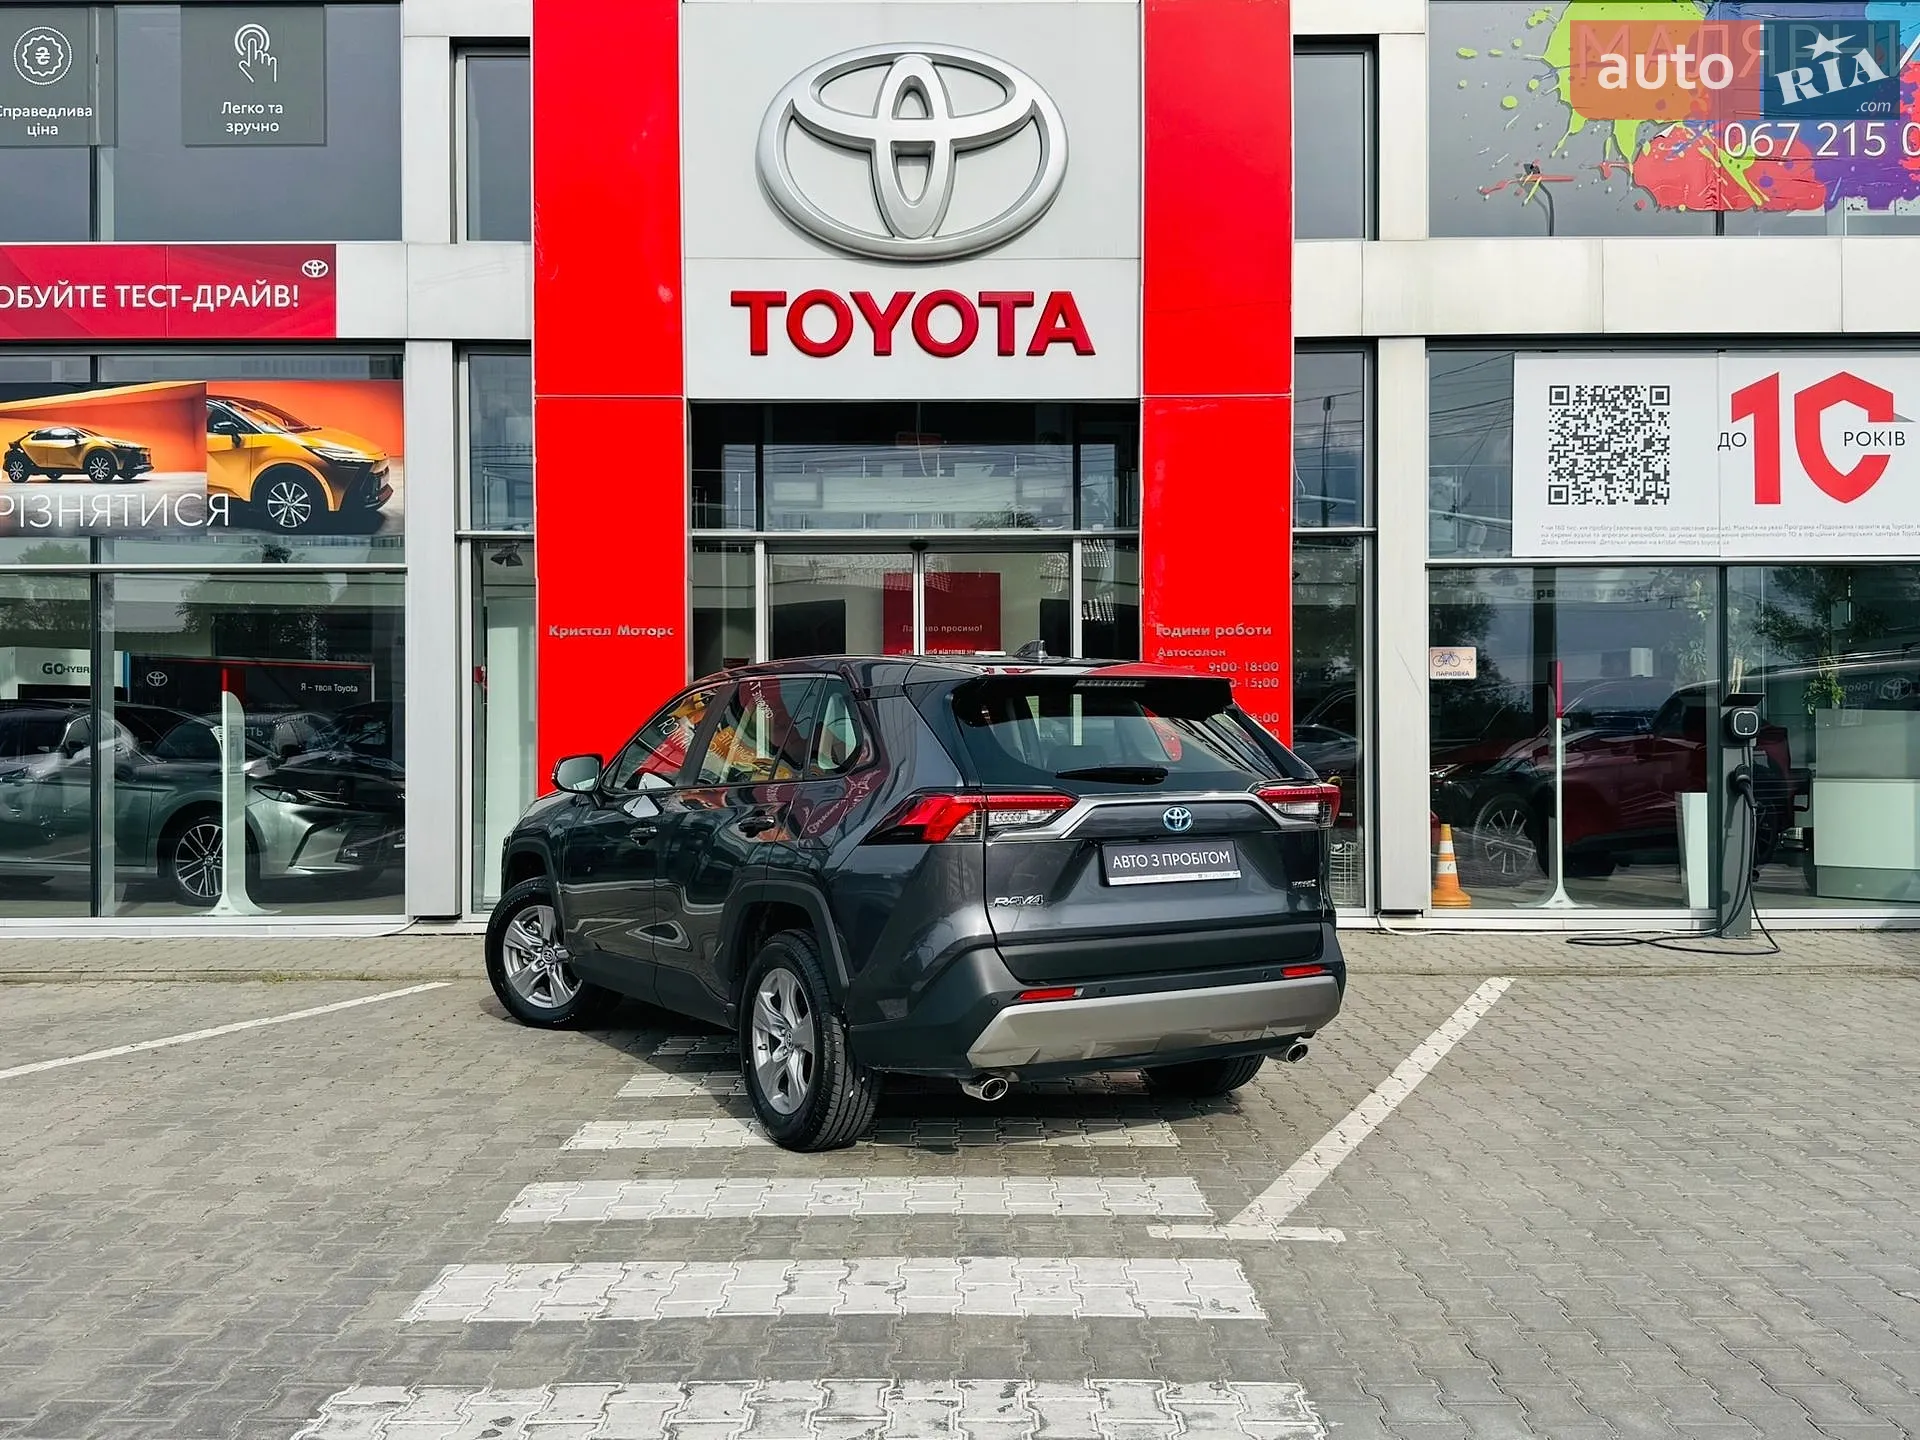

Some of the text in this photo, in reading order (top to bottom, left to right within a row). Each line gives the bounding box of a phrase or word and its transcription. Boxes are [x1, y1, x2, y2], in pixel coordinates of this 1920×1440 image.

[0, 105, 93, 120] праведлива
[221, 101, 283, 114] Легко та
[27, 122, 59, 137] ціна
[226, 121, 280, 133] зручно
[1723, 122, 1800, 157] 067
[1816, 122, 1886, 157] 215
[114, 280, 299, 313] ТЕСТ-ДРАЙВ!
[730, 288, 1097, 358] TOYOTA
[1717, 431, 1747, 451] ДО
[1843, 431, 1906, 447] РОКІВ
[548, 624, 675, 639] Кристал Моторс
[941, 623, 983, 634] просимо!
[1155, 622, 1272, 639] Години роботи
[1156, 647, 1226, 658] Автосалон
[42, 662, 64, 675] GO
[1208, 661, 1279, 673] 9:00-18:00
[334, 683, 358, 694] Toyota
[1112, 850, 1231, 869] АВТО З ПРОБІГОМ
[994, 894, 1044, 907] RAV4
